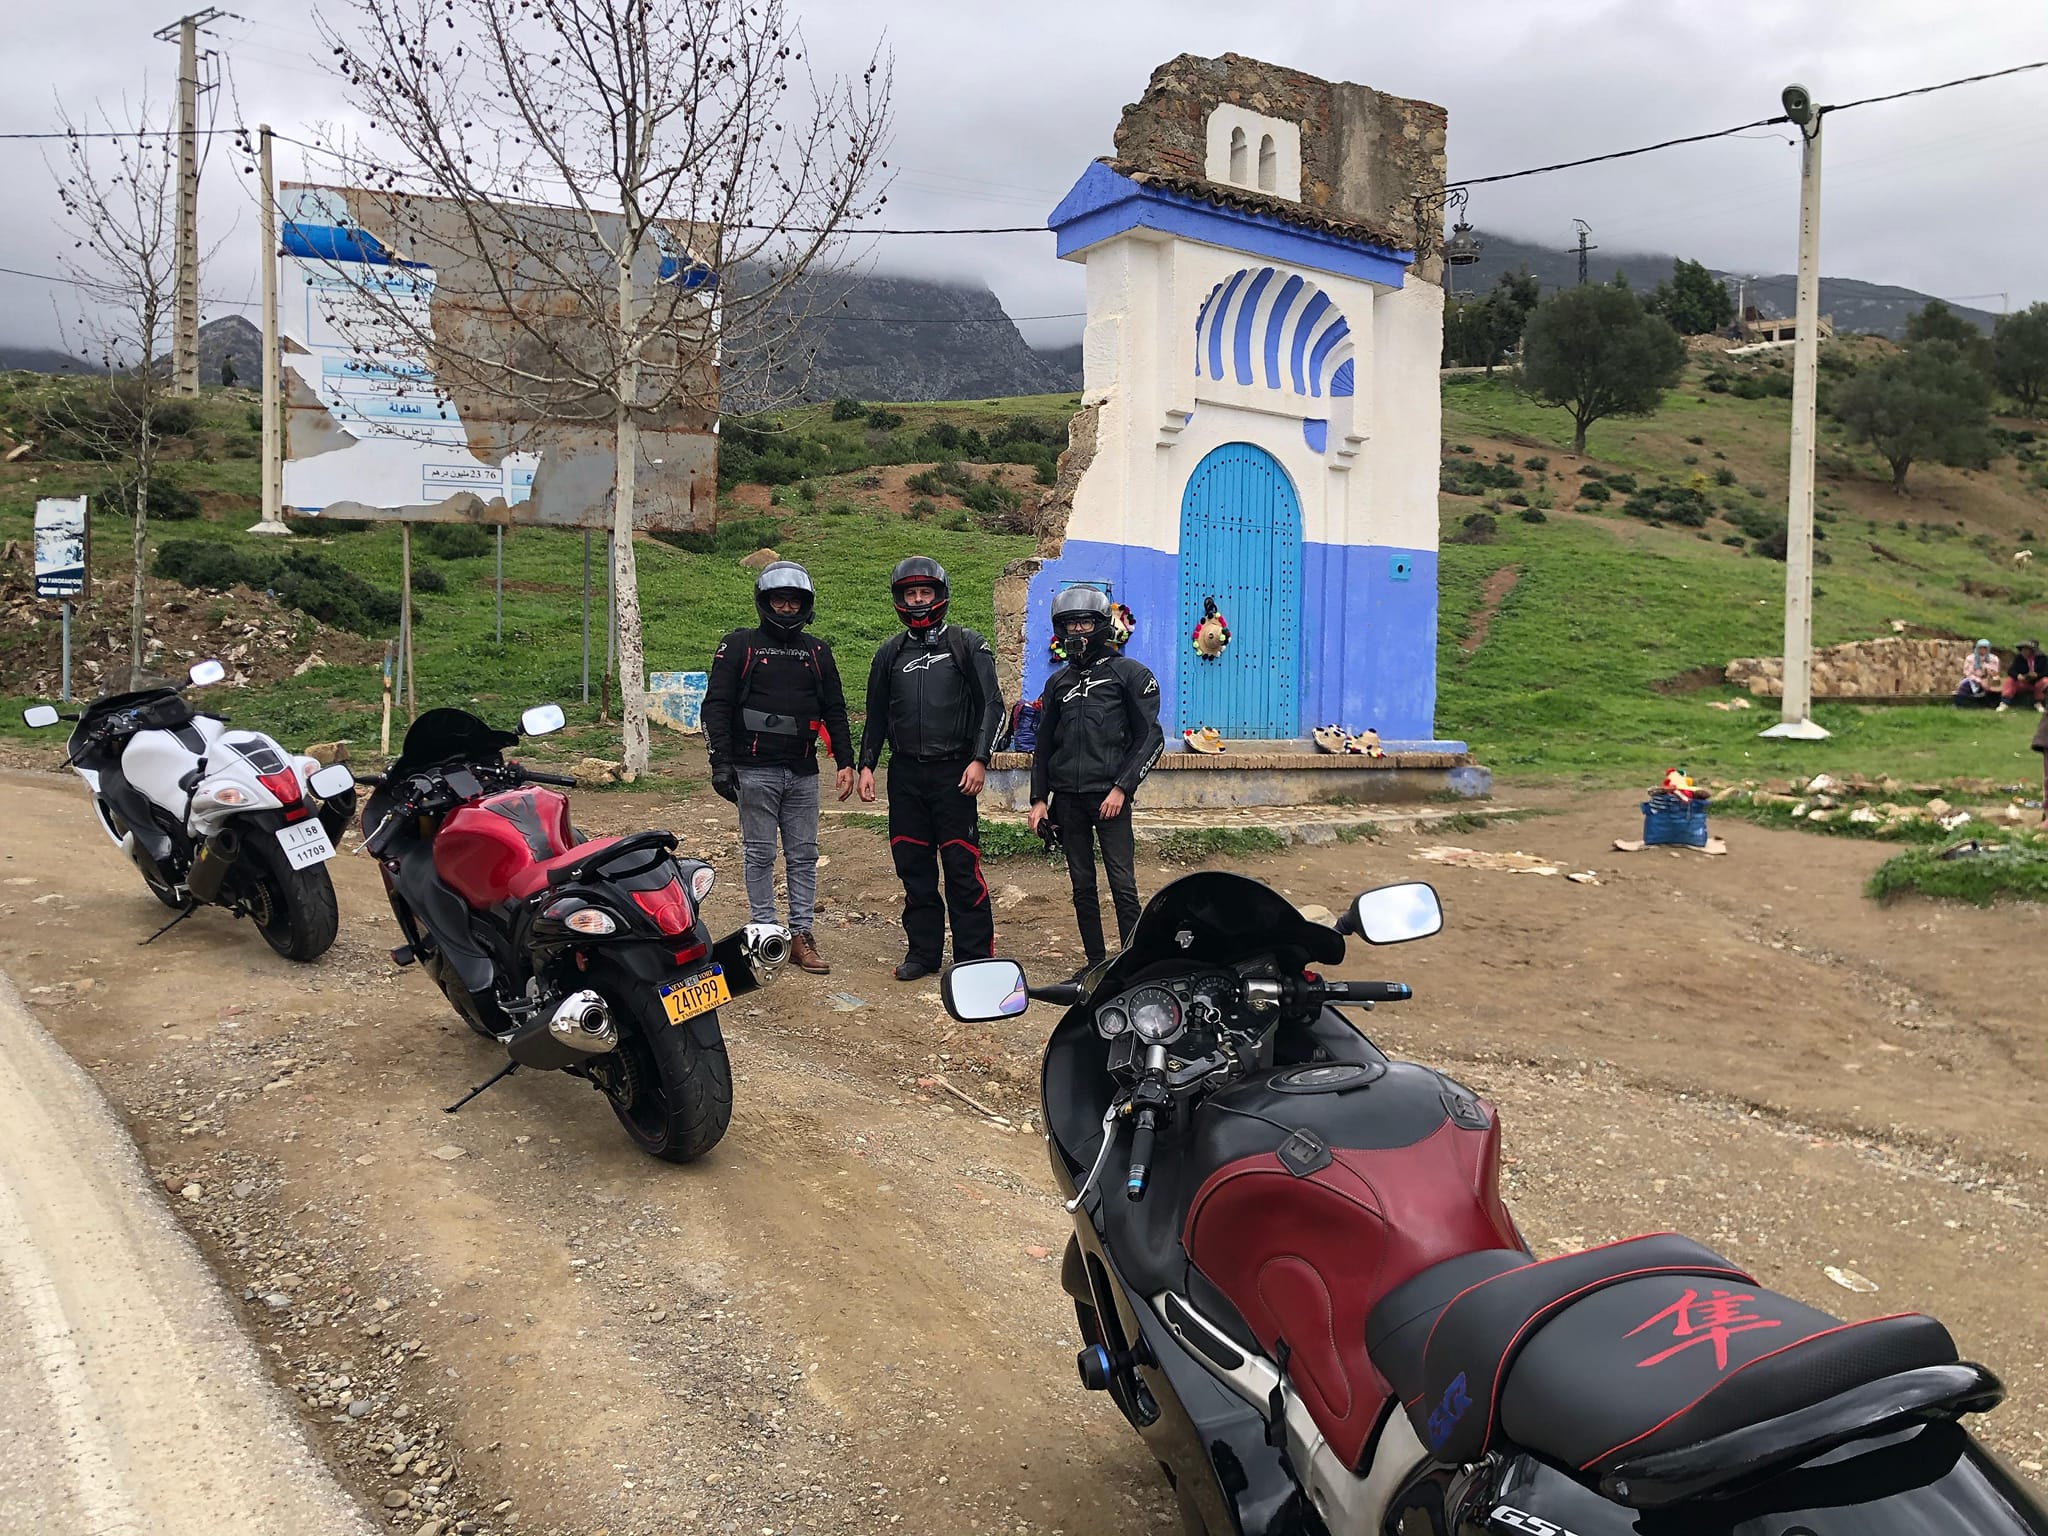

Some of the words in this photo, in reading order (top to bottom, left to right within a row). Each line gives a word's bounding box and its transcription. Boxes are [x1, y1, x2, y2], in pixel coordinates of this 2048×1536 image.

[388, 402, 421, 414] المقاولة
[305, 826, 318, 836] 58
[297, 844, 326, 861] 11709
[672, 979, 718, 1015] 24TP99
[1621, 1288, 1782, 1371] 隼
[1490, 1504, 1580, 1536] GS
